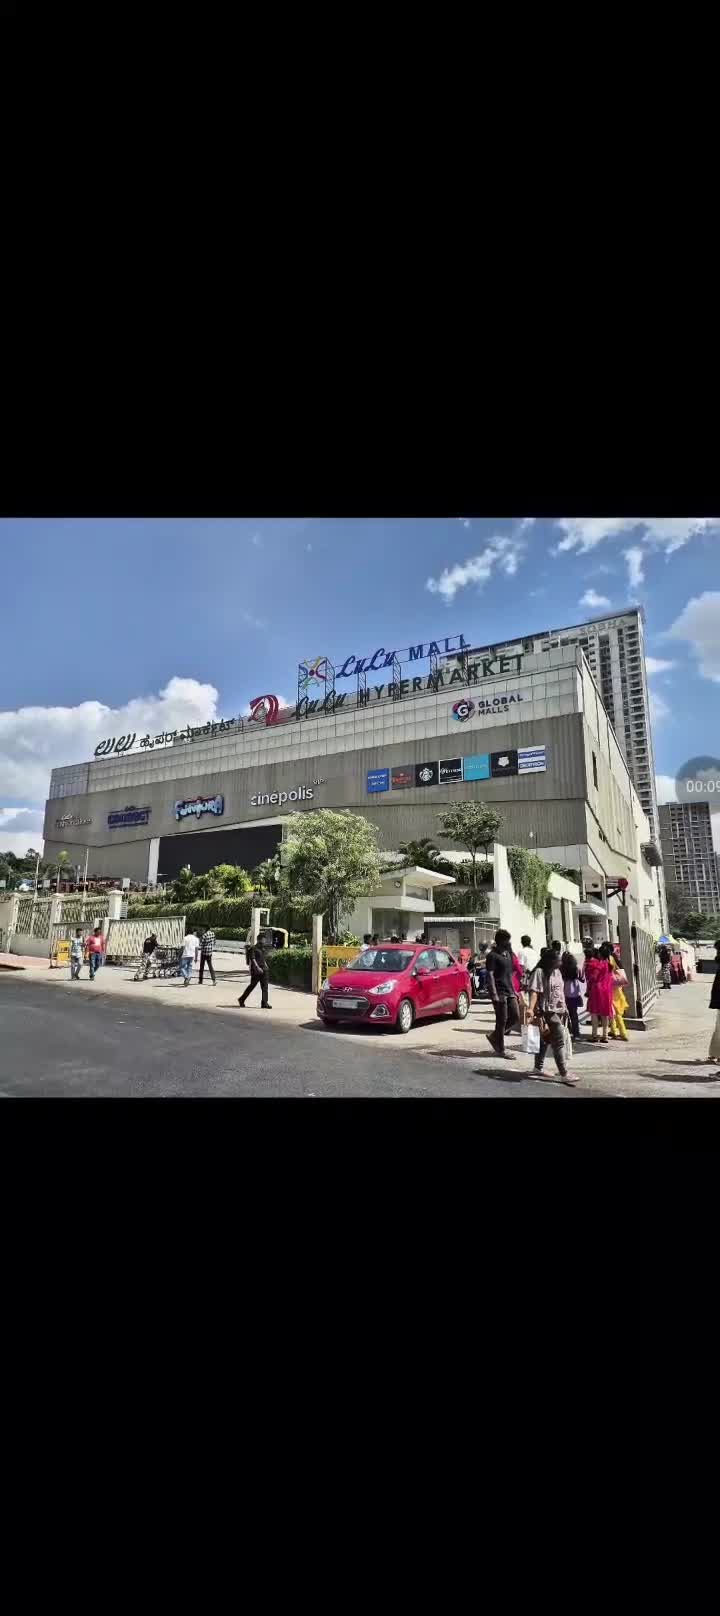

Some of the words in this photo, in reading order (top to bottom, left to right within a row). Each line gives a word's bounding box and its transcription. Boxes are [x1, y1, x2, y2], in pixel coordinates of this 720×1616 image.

[408, 634, 471, 661] MALL
[359, 652, 525, 706] HYPERMARKET
[478, 694, 524, 709] GLOBAL
[478, 705, 510, 717] MALLS
